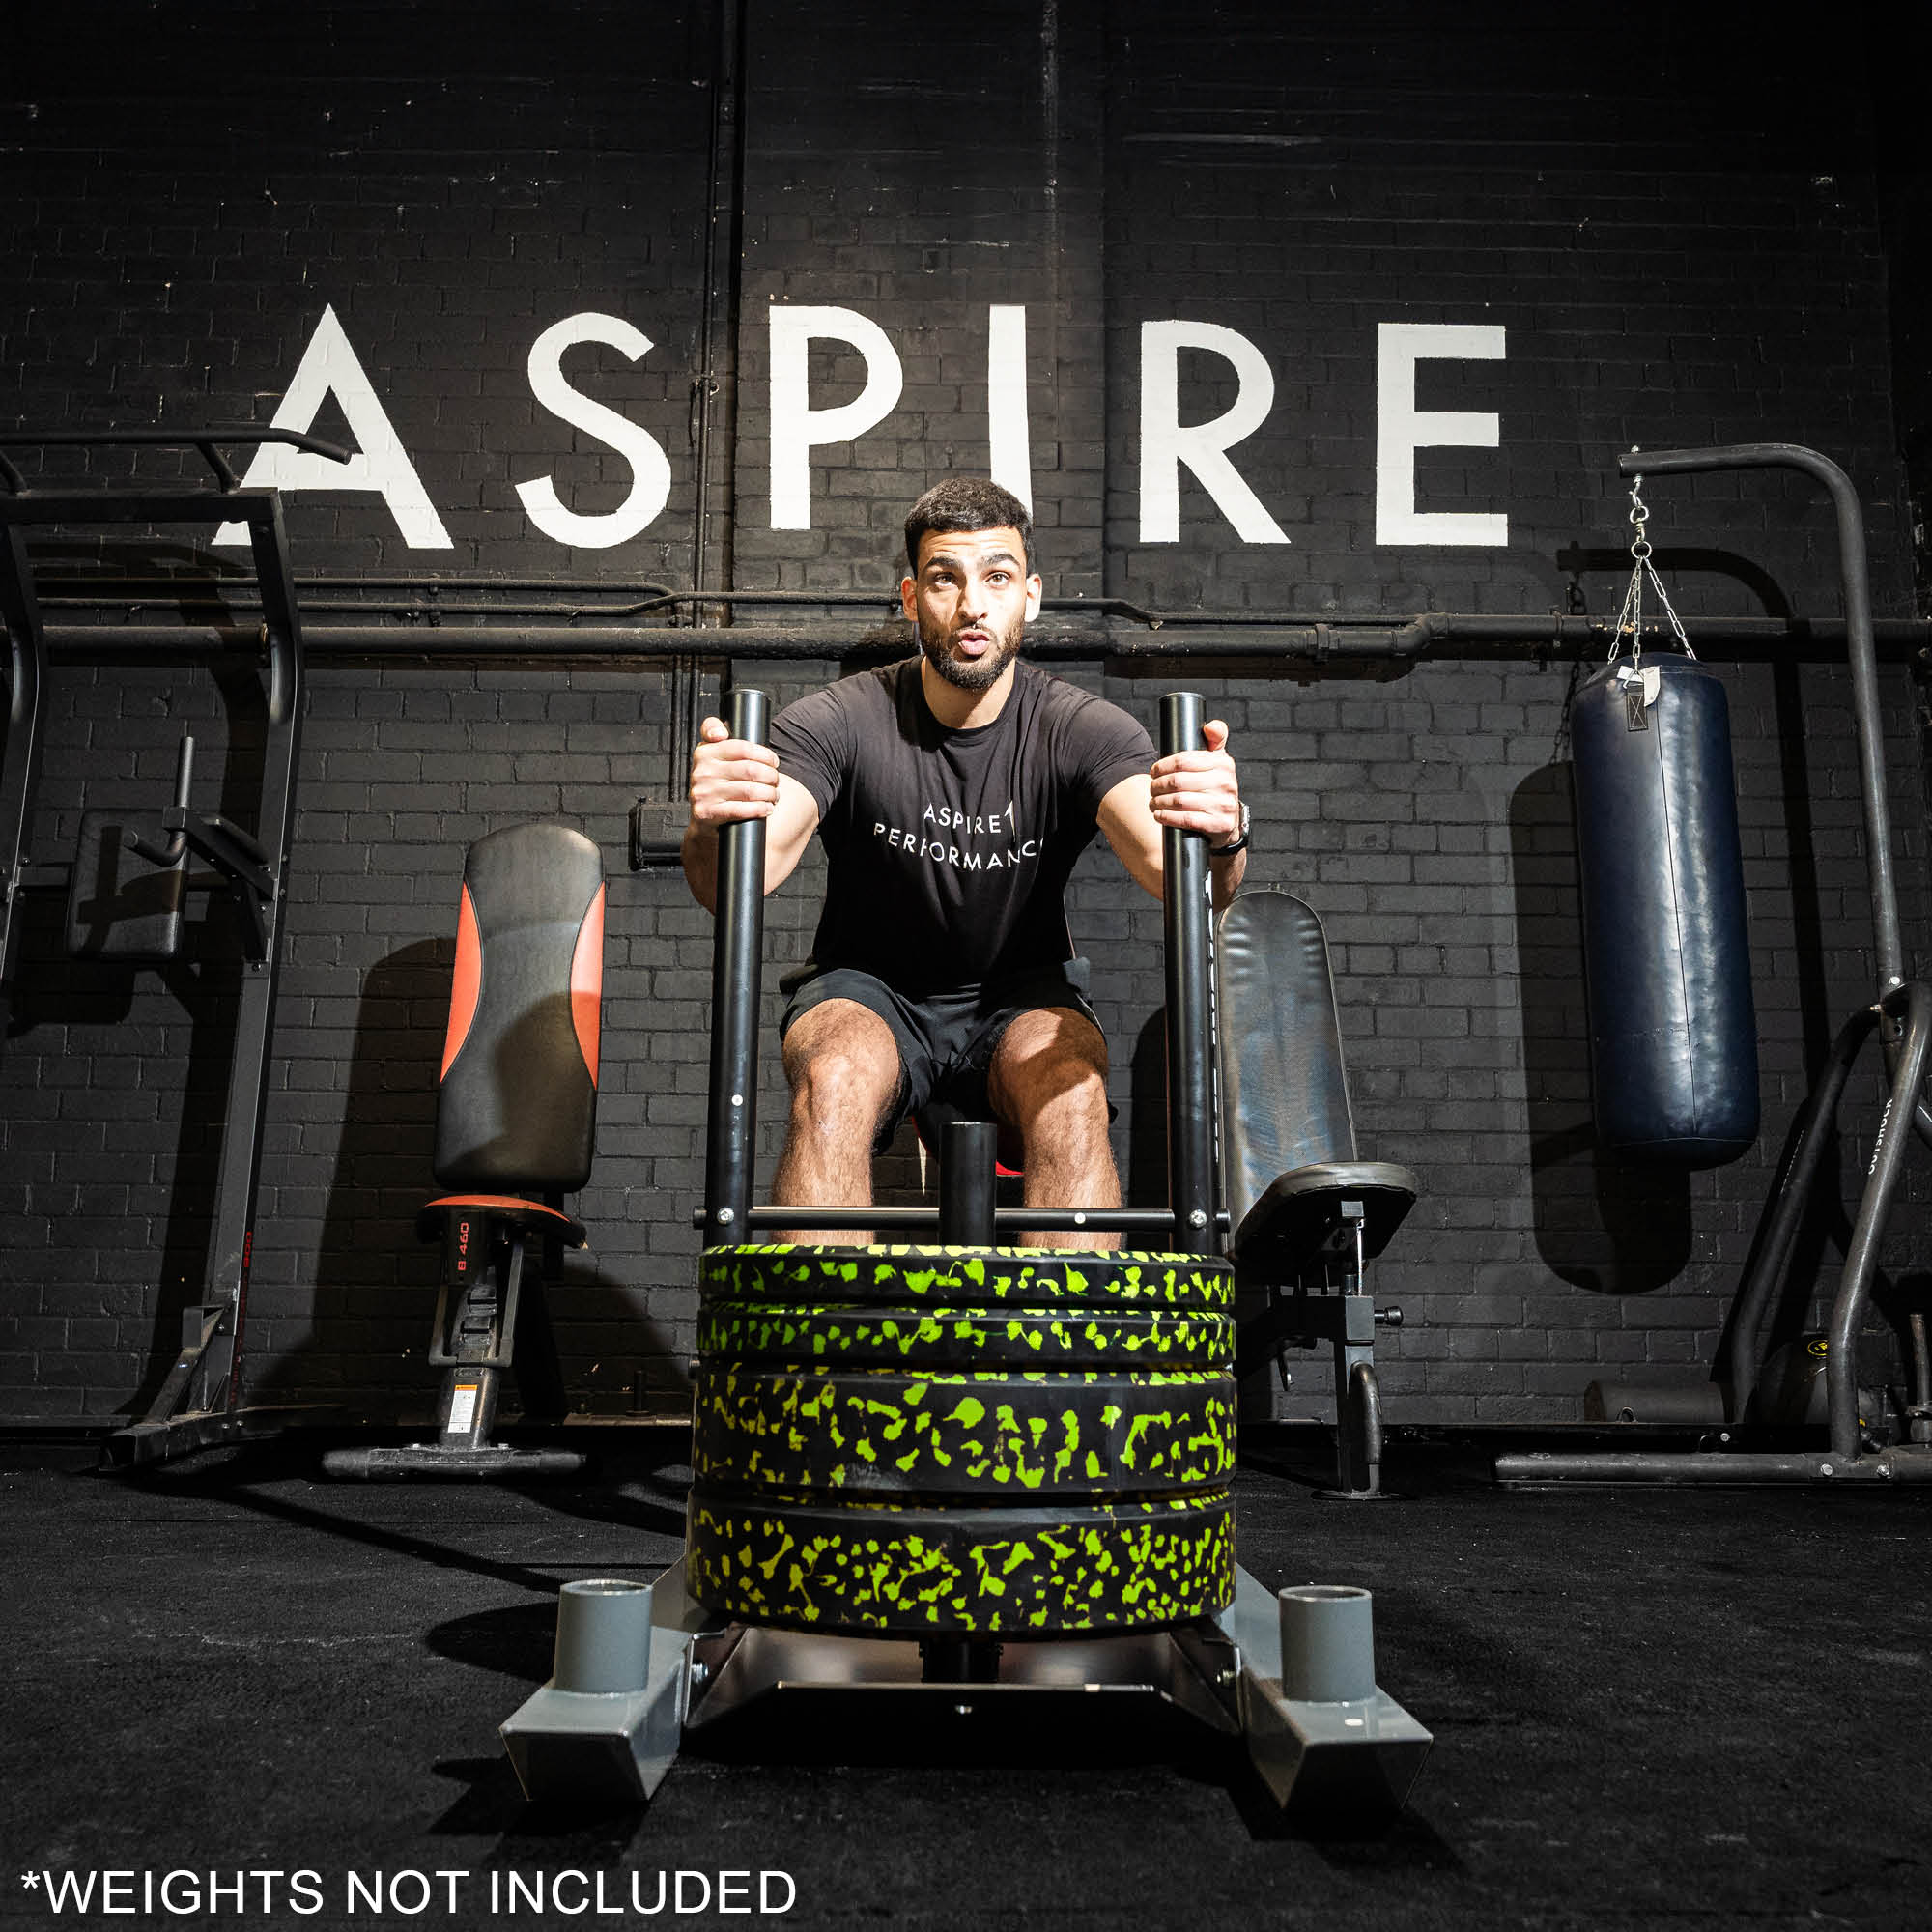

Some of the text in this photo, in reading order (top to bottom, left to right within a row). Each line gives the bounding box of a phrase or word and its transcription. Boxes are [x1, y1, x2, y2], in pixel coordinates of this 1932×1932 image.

[211, 303, 1508, 548] ASPIRE
[923, 803, 1002, 835] ASPIRE
[873, 822, 1044, 871] PERFORMANC
[459, 1222, 470, 1256] 460
